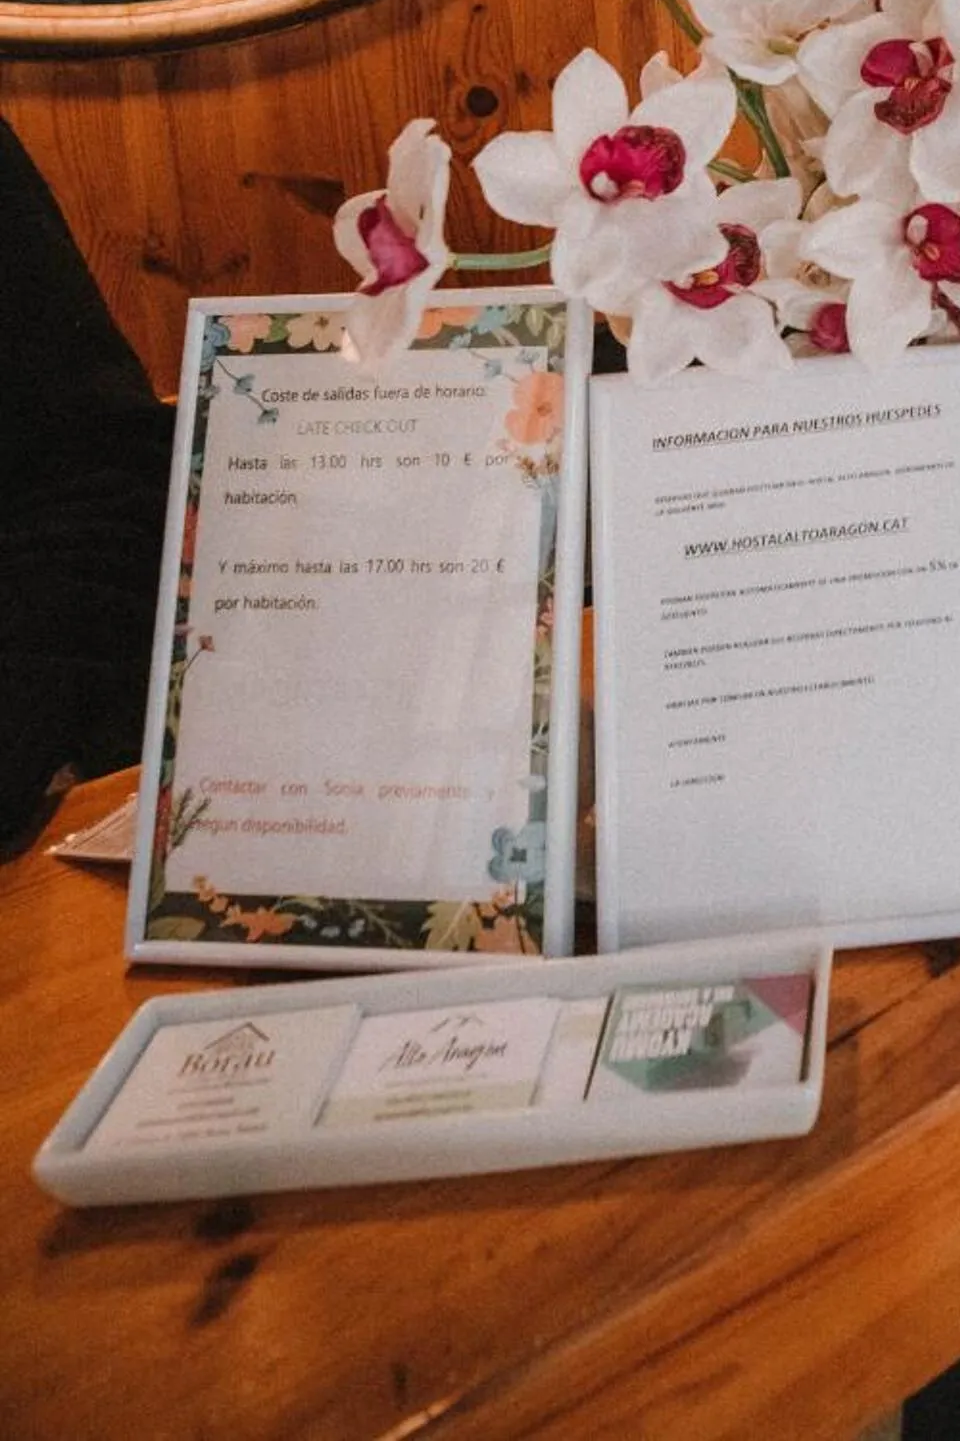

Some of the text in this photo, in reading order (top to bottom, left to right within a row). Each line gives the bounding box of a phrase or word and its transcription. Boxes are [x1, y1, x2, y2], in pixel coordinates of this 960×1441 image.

[261, 388, 299, 403] Coste
[302, 387, 320, 402] de
[323, 386, 370, 402] salidas
[374, 385, 410, 401] fuera
[414, 384, 431, 400] de
[297, 417, 417, 435] LATE CHECK OUT
[753, 421, 789, 439] PARA
[792, 411, 863, 433] NUESTROS
[865, 403, 943, 425] HUESPEDES
[227, 455, 269, 471] Hasta
[360, 454, 382, 469] hrs
[396, 455, 421, 468] son
[434, 453, 450, 467] 10
[218, 558, 228, 574] Y
[294, 558, 332, 574] hasta
[339, 559, 359, 574] las
[410, 559, 433, 574] hrs
[439, 561, 464, 574] son
[213, 598, 240, 615] por
[280, 781, 309, 796] con
